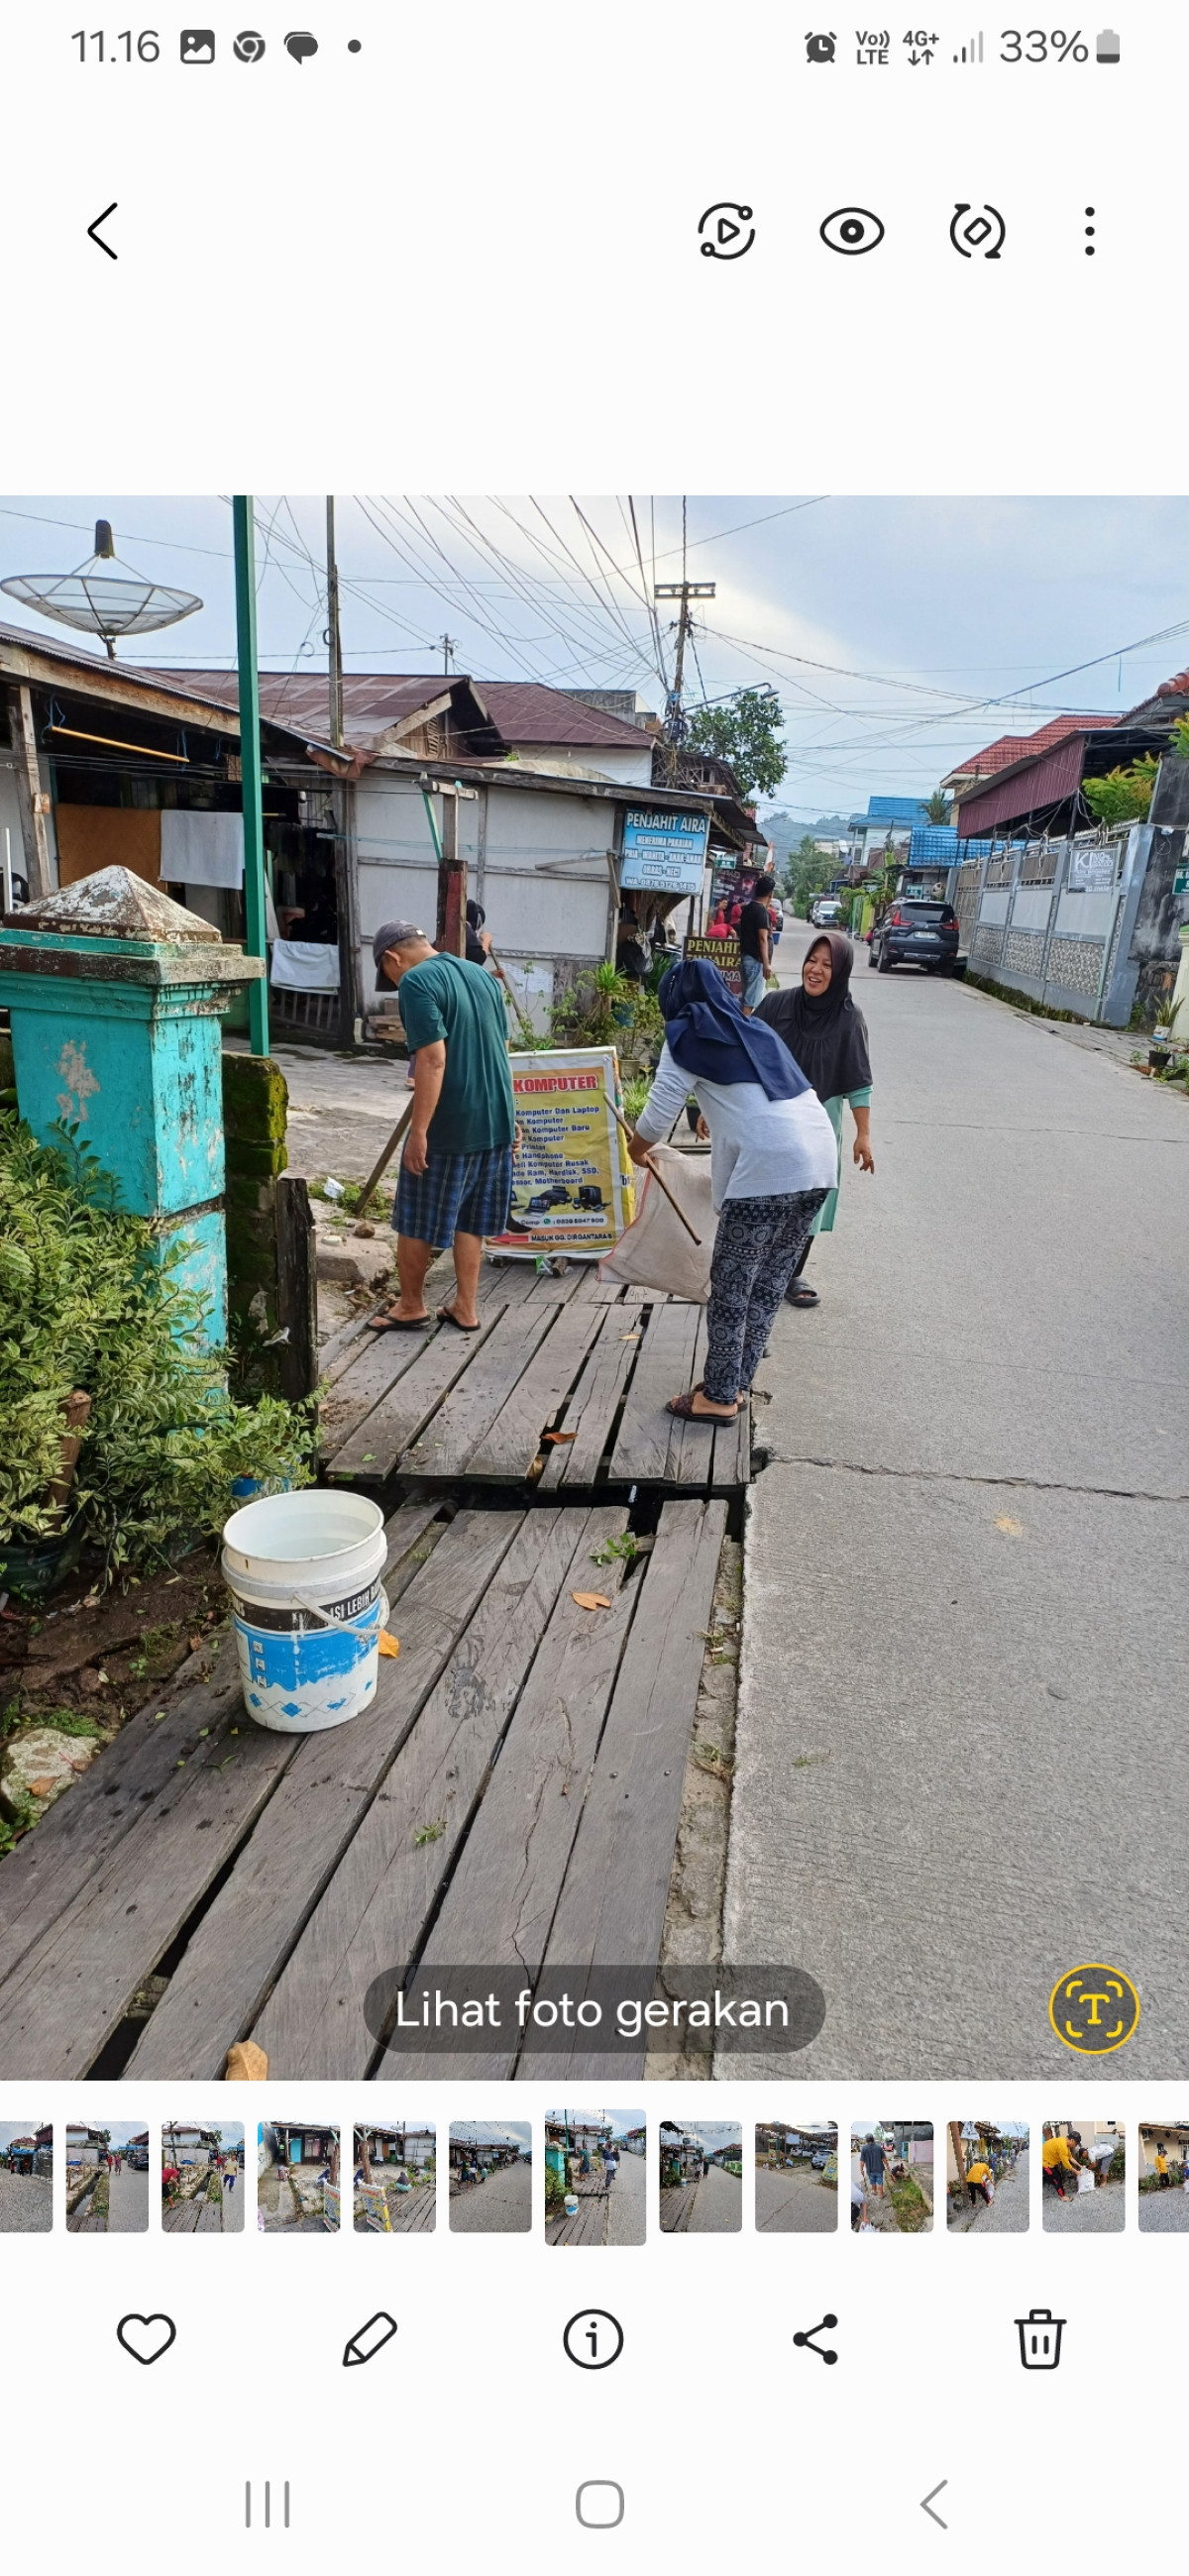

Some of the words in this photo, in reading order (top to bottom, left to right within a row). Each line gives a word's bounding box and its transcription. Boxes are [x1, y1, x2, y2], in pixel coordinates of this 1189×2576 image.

[71, 31, 160, 62] 11.16
[903, 31, 939, 47] 4G+
[1001, 31, 1088, 62] 33%
[857, 50, 889, 64] LTE
[626, 812, 679, 831] PENJAHIT
[680, 816, 705, 833] AIRA
[513, 1075, 597, 1093] KOMPUTER
[573, 1106, 599, 1115] Laptop
[347, 1589, 370, 1616] LEBIH
